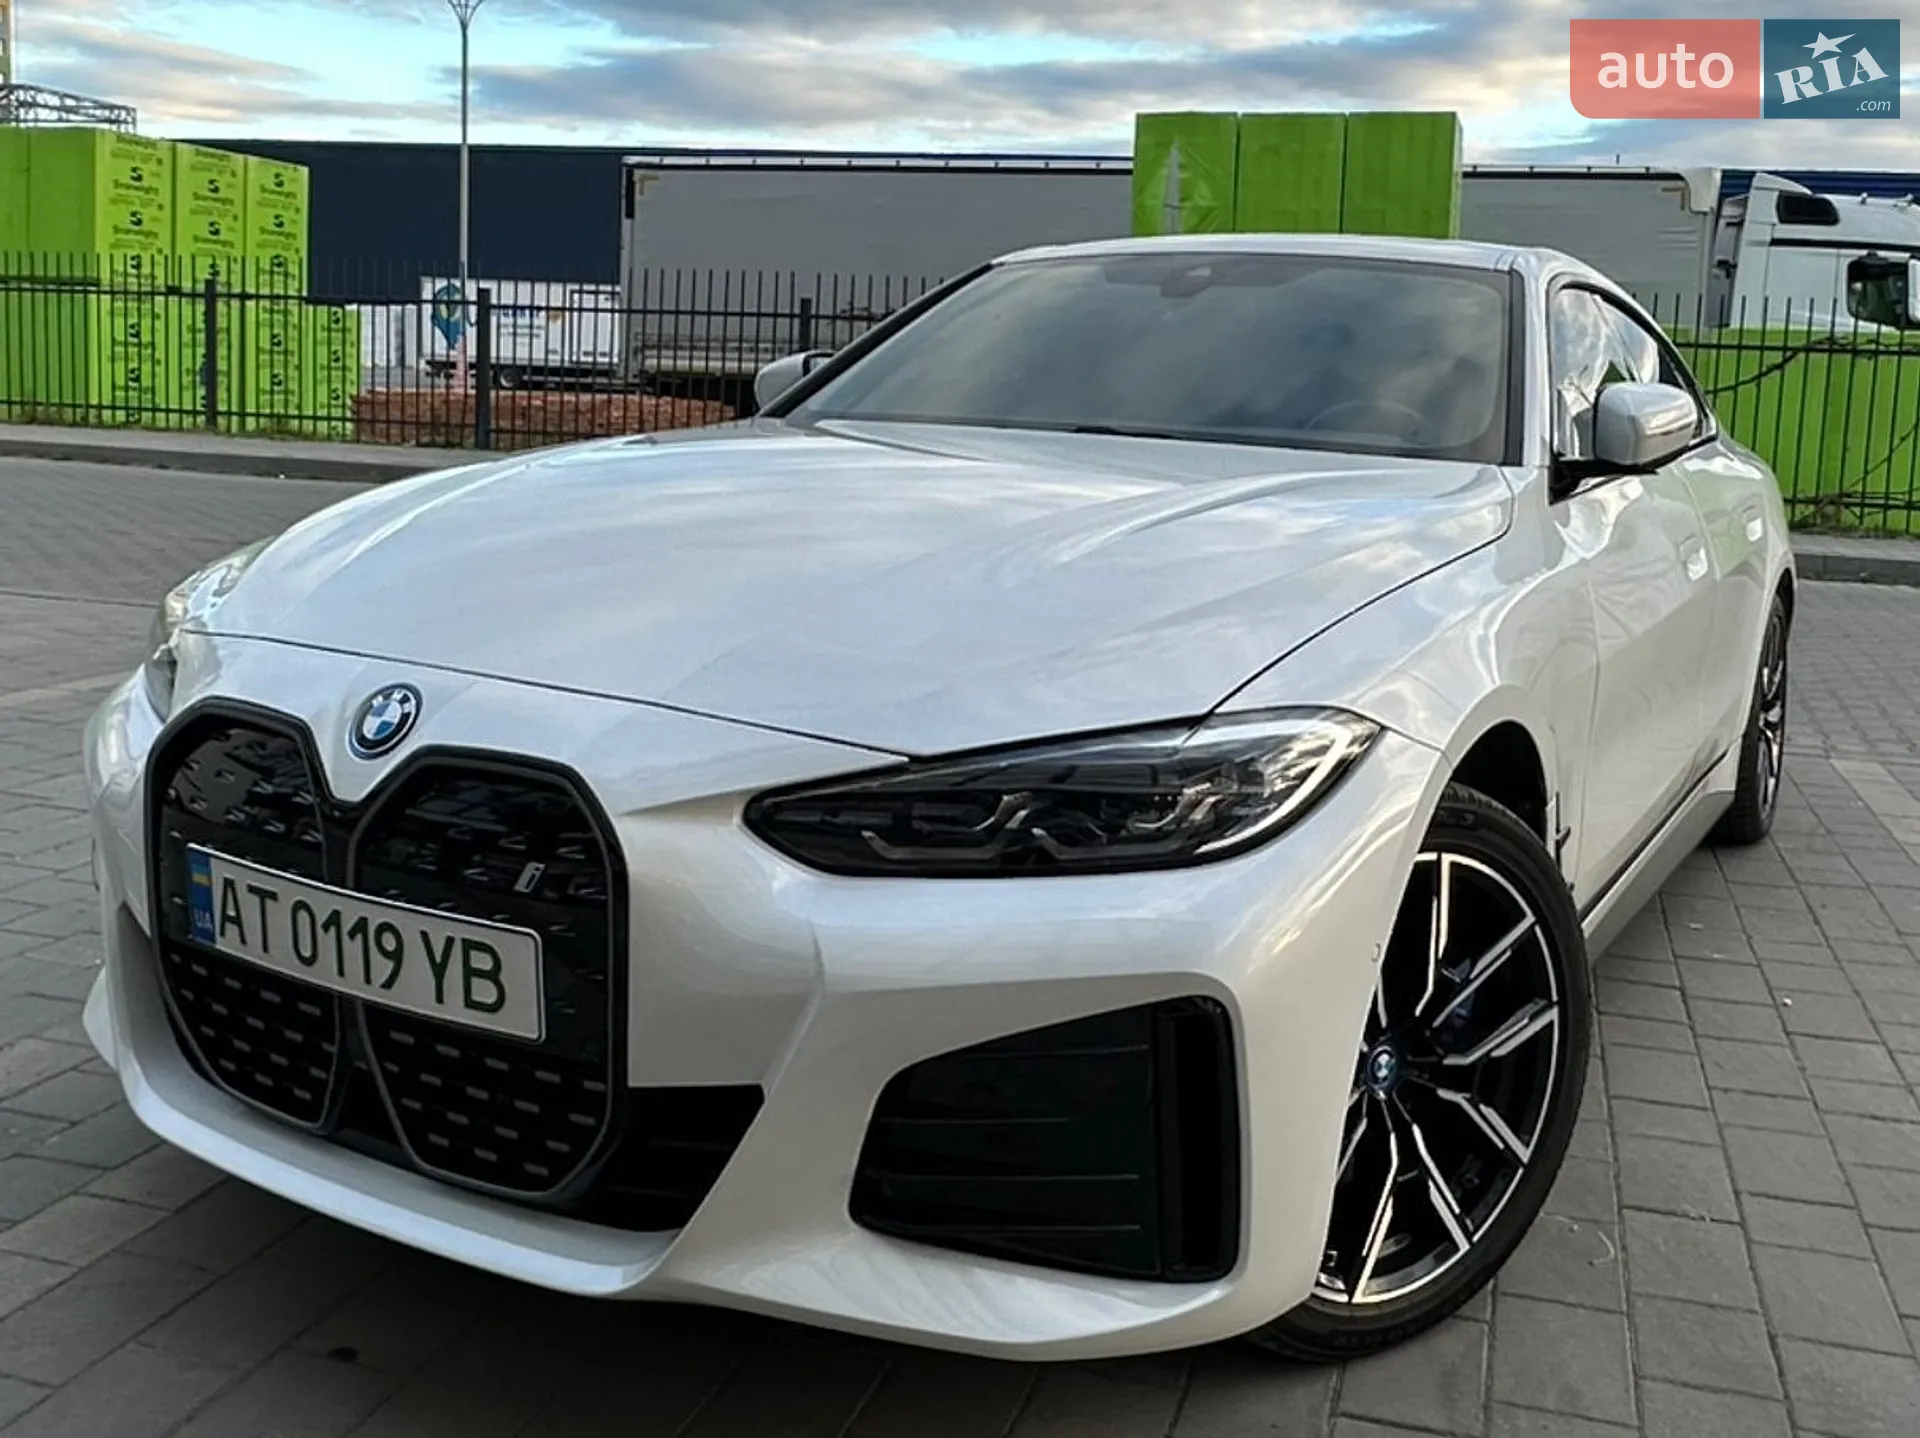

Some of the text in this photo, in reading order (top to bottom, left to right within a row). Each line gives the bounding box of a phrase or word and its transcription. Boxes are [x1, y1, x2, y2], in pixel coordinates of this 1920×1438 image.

[194, 912, 214, 931] UA
[219, 876, 507, 1014] AT 0119 YB
